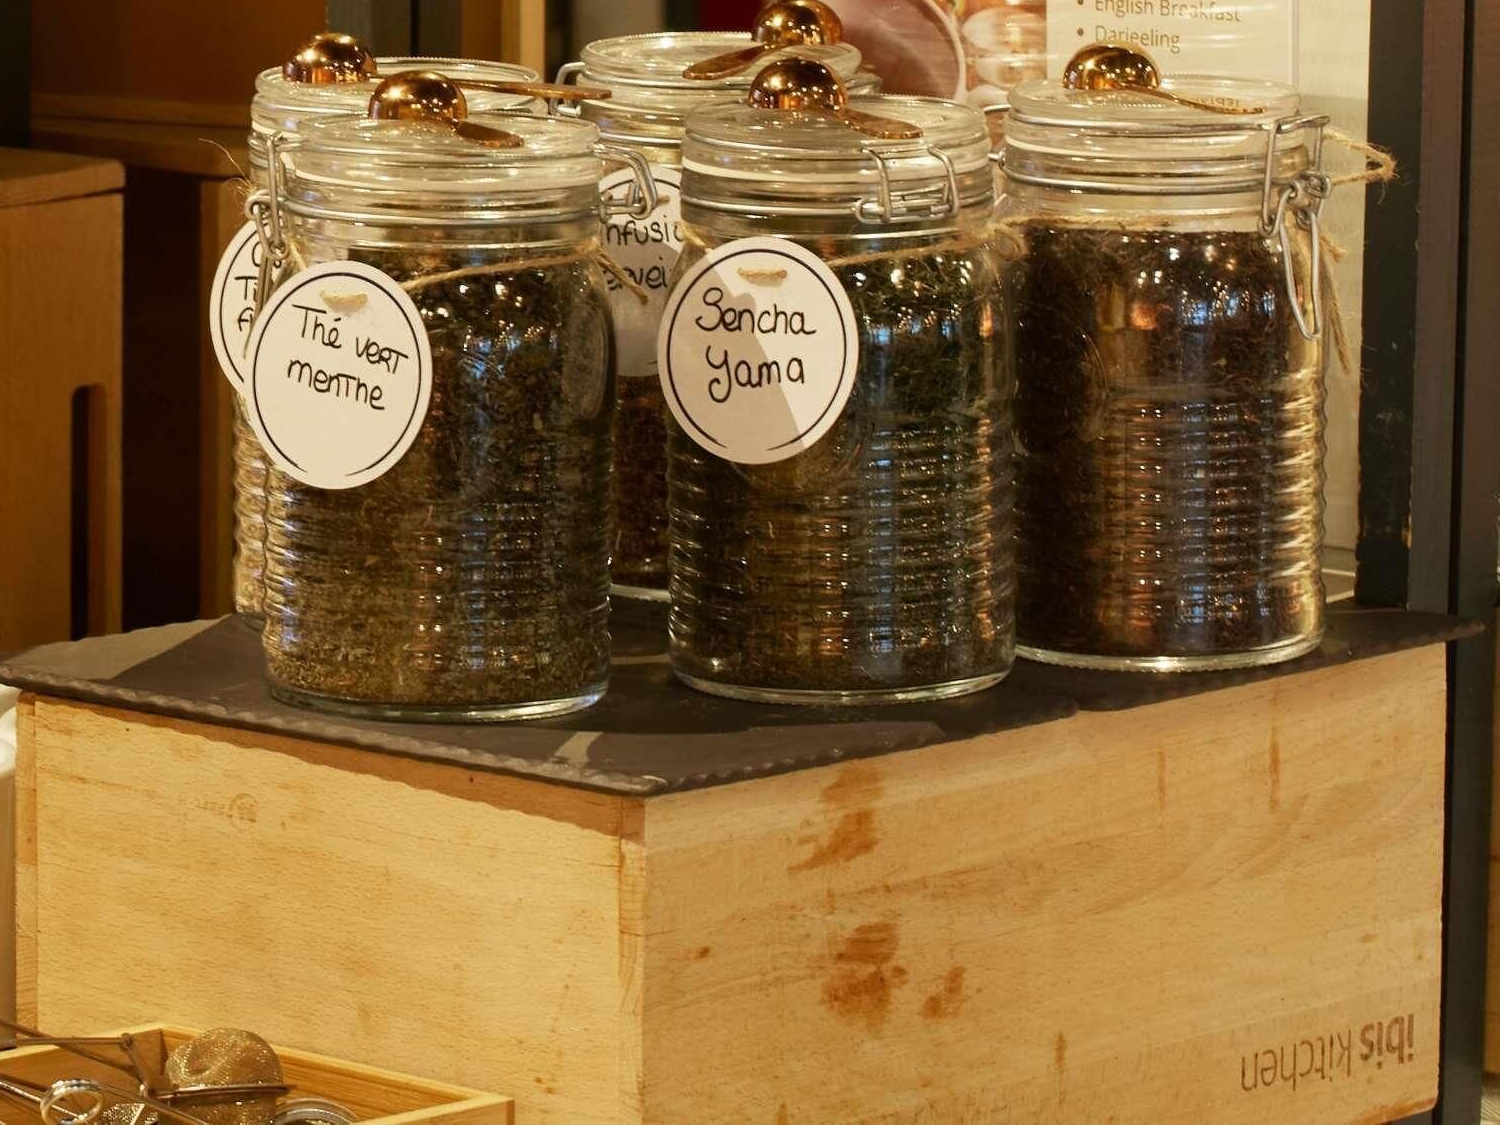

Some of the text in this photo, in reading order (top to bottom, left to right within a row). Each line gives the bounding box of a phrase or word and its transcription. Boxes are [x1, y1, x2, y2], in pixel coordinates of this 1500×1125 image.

[292, 303, 342, 349] Thé
[695, 287, 817, 335] Sencha
[1241, 1013, 1414, 1091] ibis kitchen
